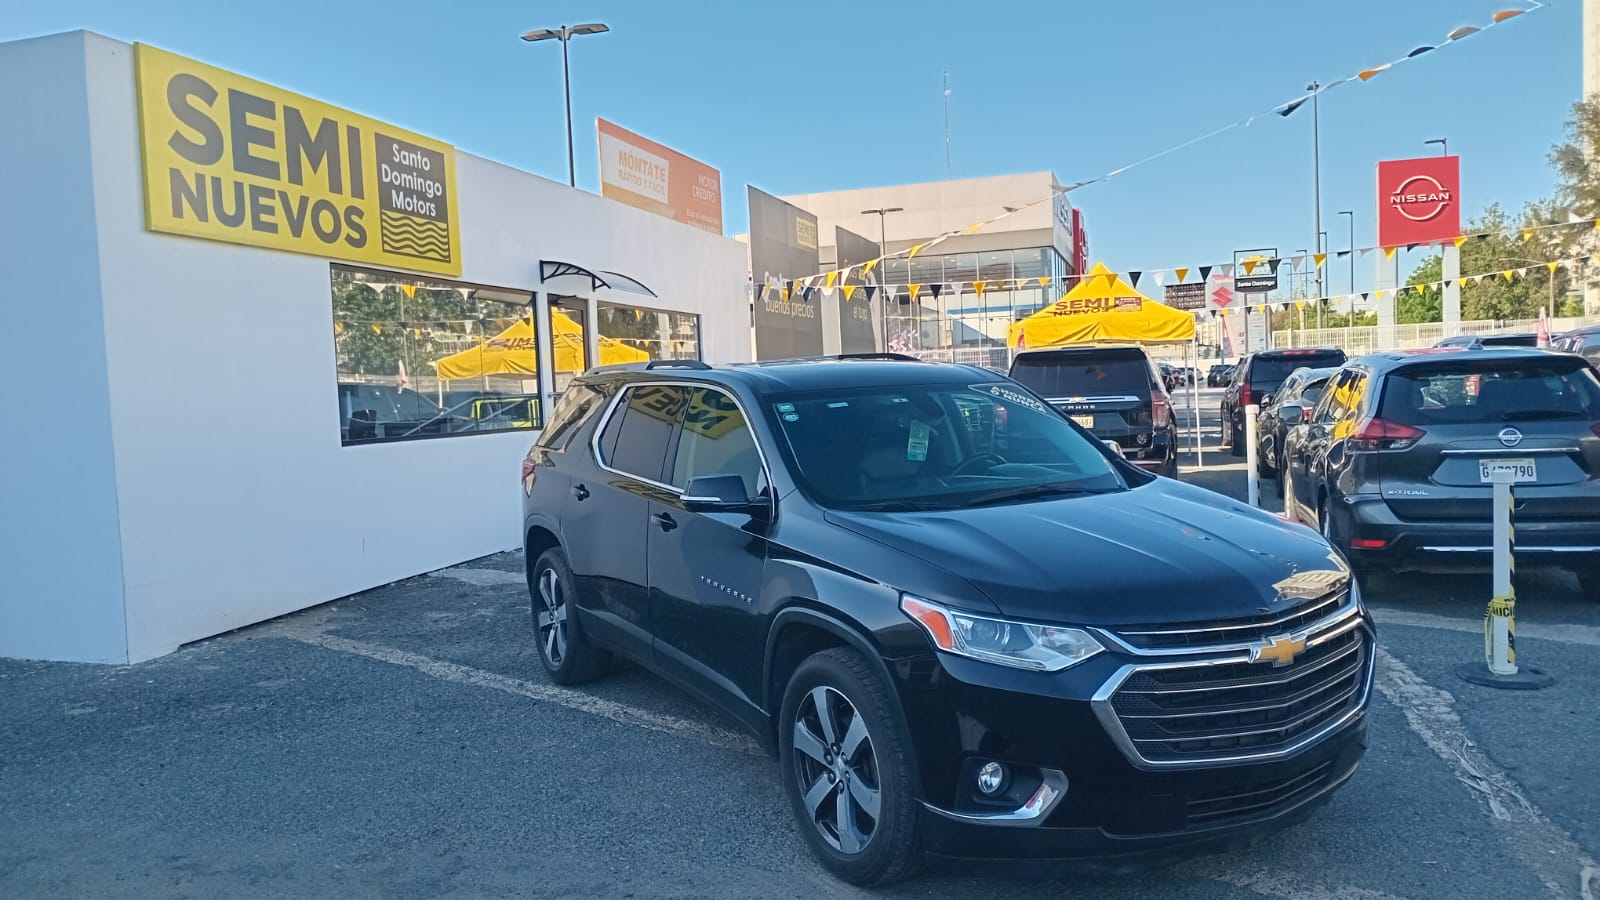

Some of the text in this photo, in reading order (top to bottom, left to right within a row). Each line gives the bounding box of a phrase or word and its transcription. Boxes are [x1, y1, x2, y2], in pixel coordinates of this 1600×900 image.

[167, 73, 364, 200] SEMI
[392, 143, 430, 171] Santo
[618, 149, 666, 182] MÓNTATE
[381, 163, 442, 198] Domingo
[169, 167, 367, 248] NUEVOS
[391, 189, 436, 217] Motors
[1390, 192, 1449, 203] NISSAN
[1055, 298, 1109, 310] SEMI
[1482, 465, 1534, 478] G790
